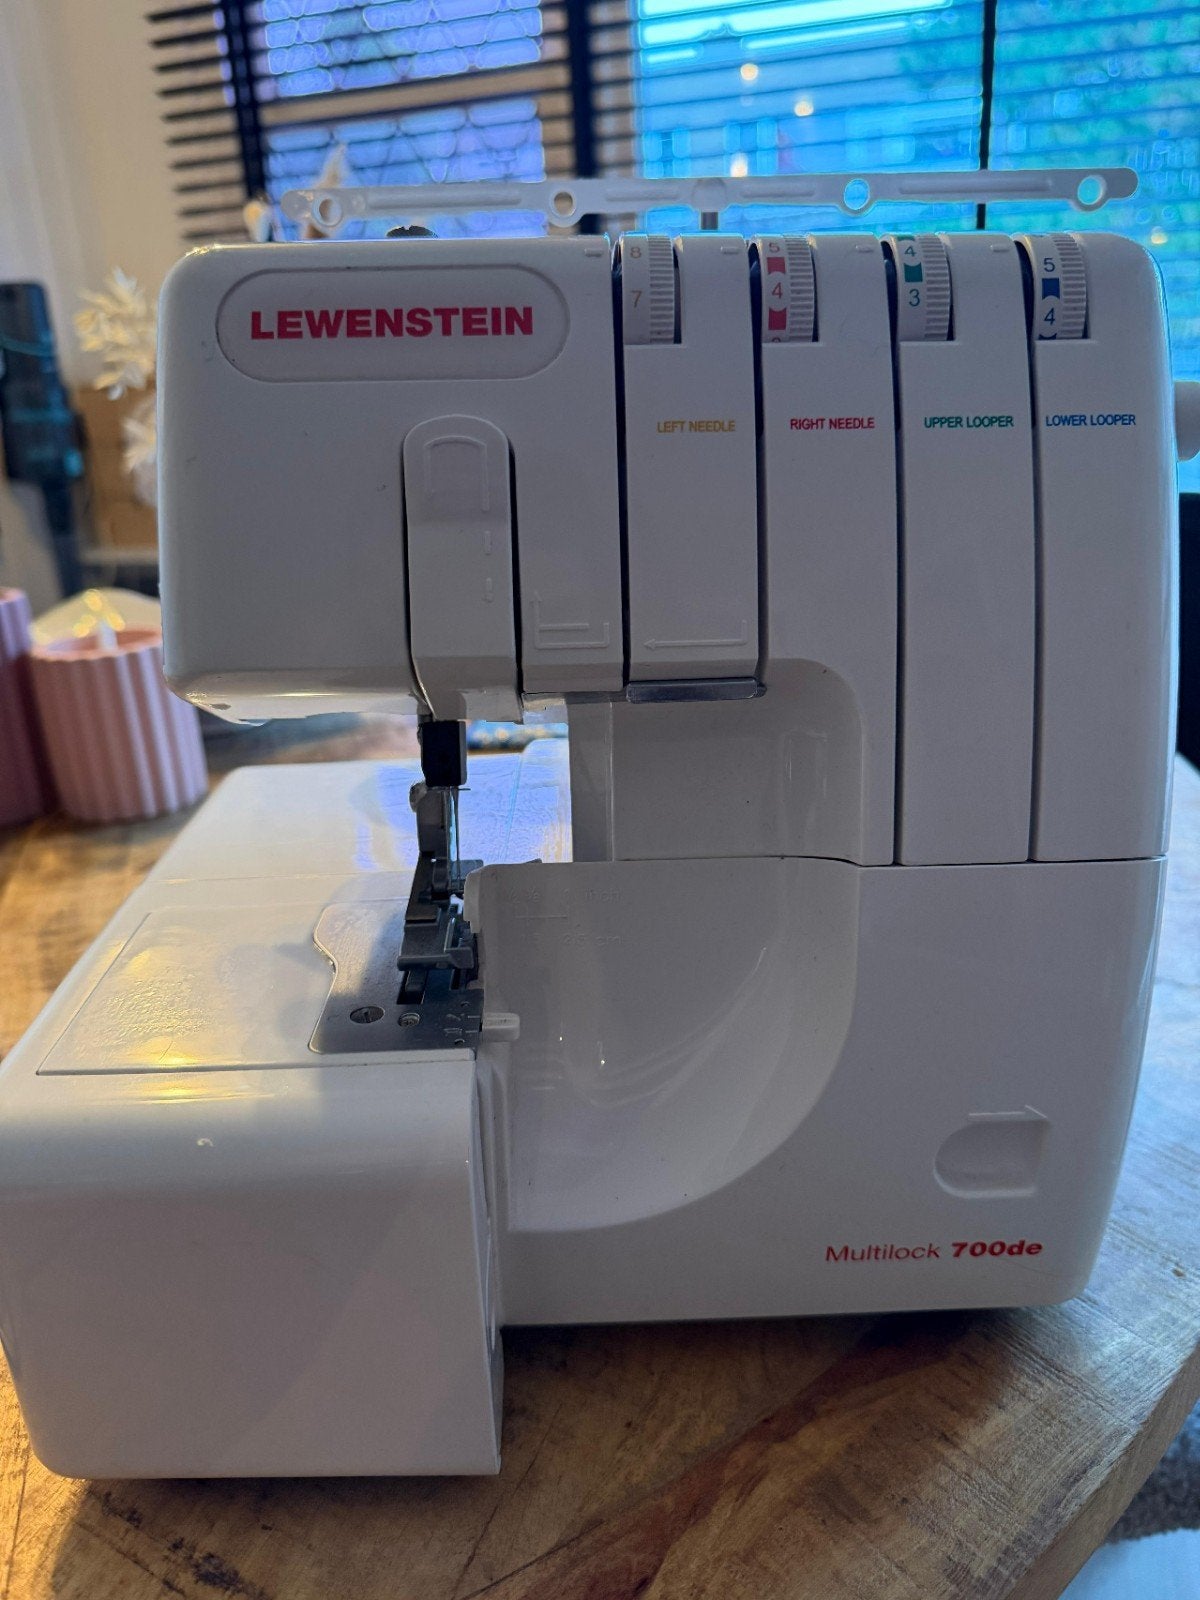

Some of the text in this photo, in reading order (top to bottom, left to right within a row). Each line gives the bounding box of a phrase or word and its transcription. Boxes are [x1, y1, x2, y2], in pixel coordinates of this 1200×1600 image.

[629, 246, 642, 259] 8
[768, 243, 781, 253] 5
[904, 245, 918, 258] 4
[1043, 257, 1055, 273] 5
[771, 281, 783, 299] 4
[629, 290, 642, 308] 7
[908, 288, 921, 307] 3
[251, 307, 534, 340] LEWENSTEIN
[1043, 307, 1056, 326] 4
[657, 420, 736, 433] LEFT NEEDLE
[790, 417, 875, 430] RIGHT NEEDLE
[924, 415, 1014, 428] UPPER LOOPER
[1046, 414, 1136, 427] LOWER LOOPER
[825, 1240, 1042, 1261] Multilock 700de
